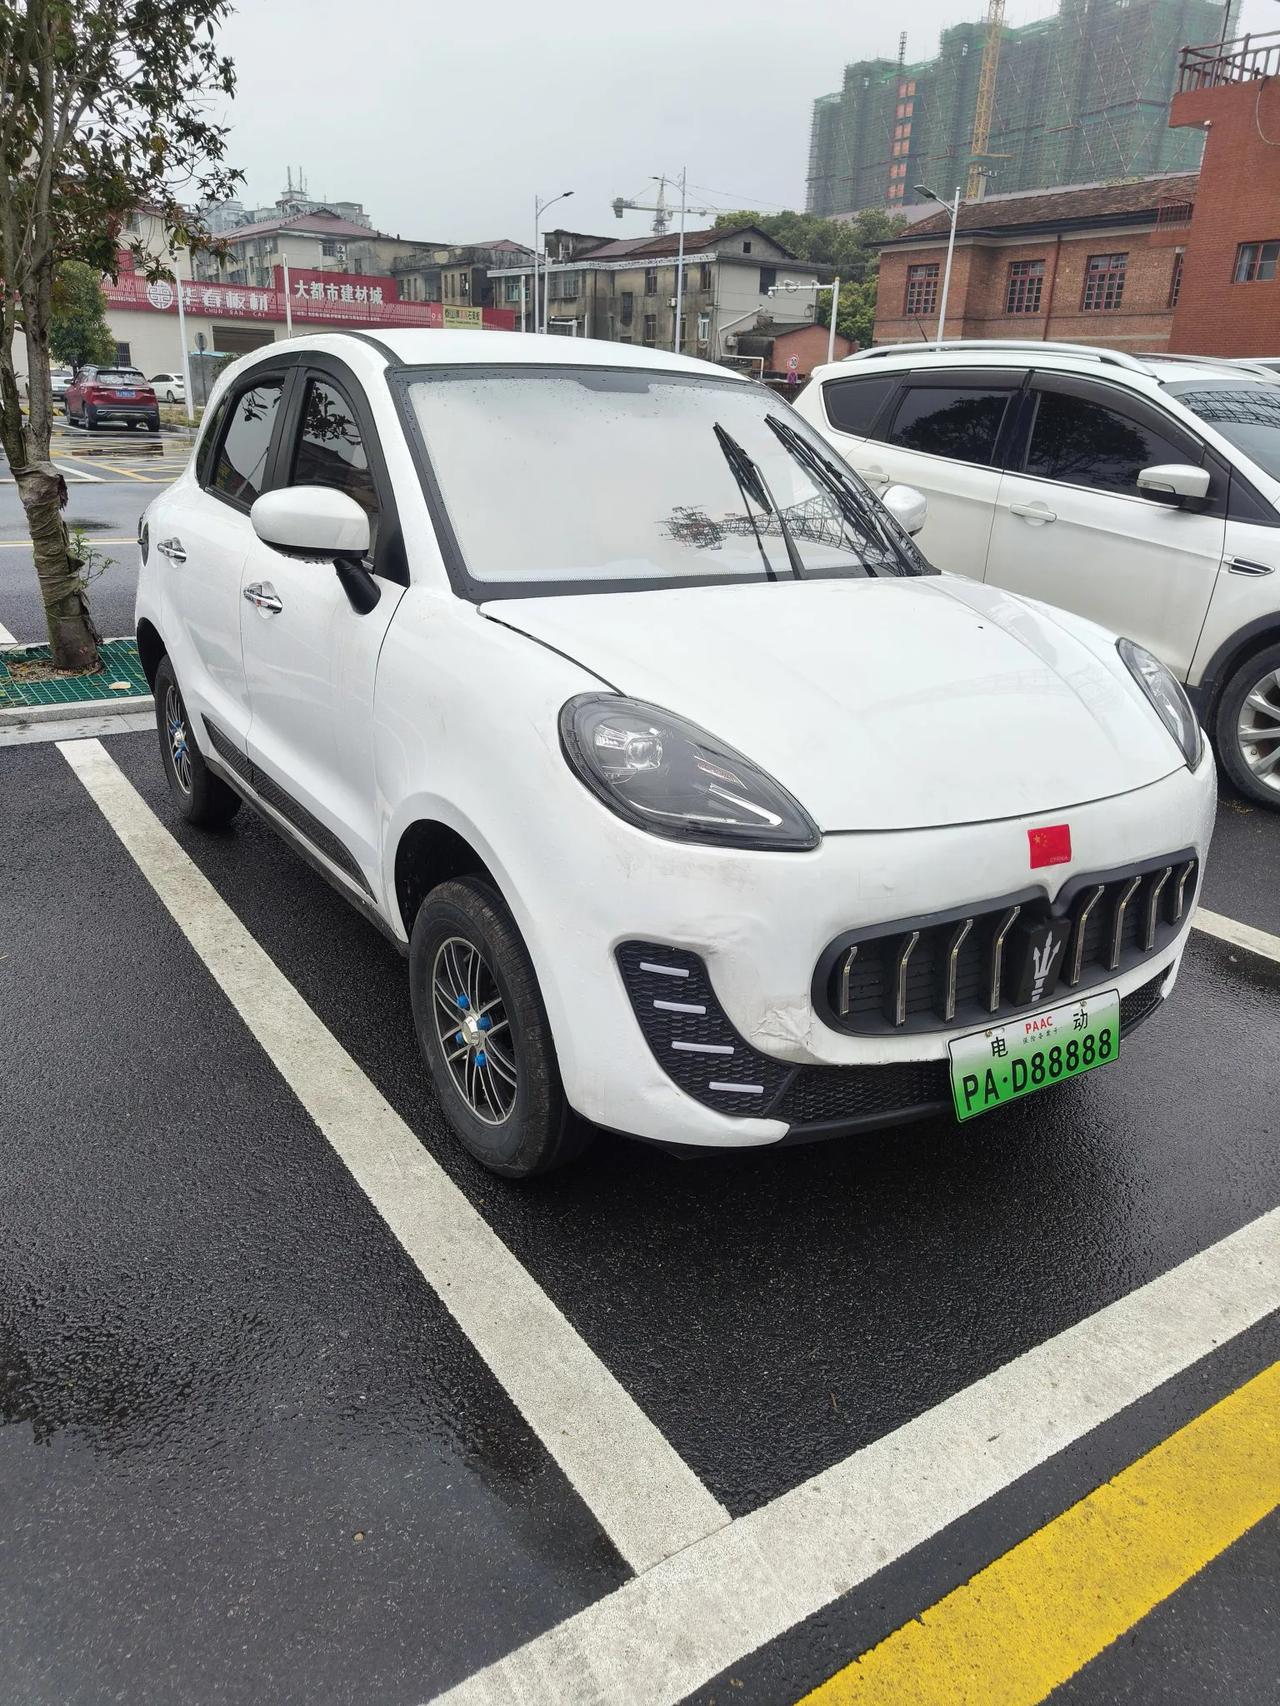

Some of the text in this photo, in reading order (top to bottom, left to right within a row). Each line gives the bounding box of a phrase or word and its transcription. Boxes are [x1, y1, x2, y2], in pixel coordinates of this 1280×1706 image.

[182, 286, 268, 312] 华春板材
[294, 279, 384, 306] 大都市建材城
[990, 1008, 1089, 1058] 电 动
[1025, 1015, 1054, 1035] PAAC
